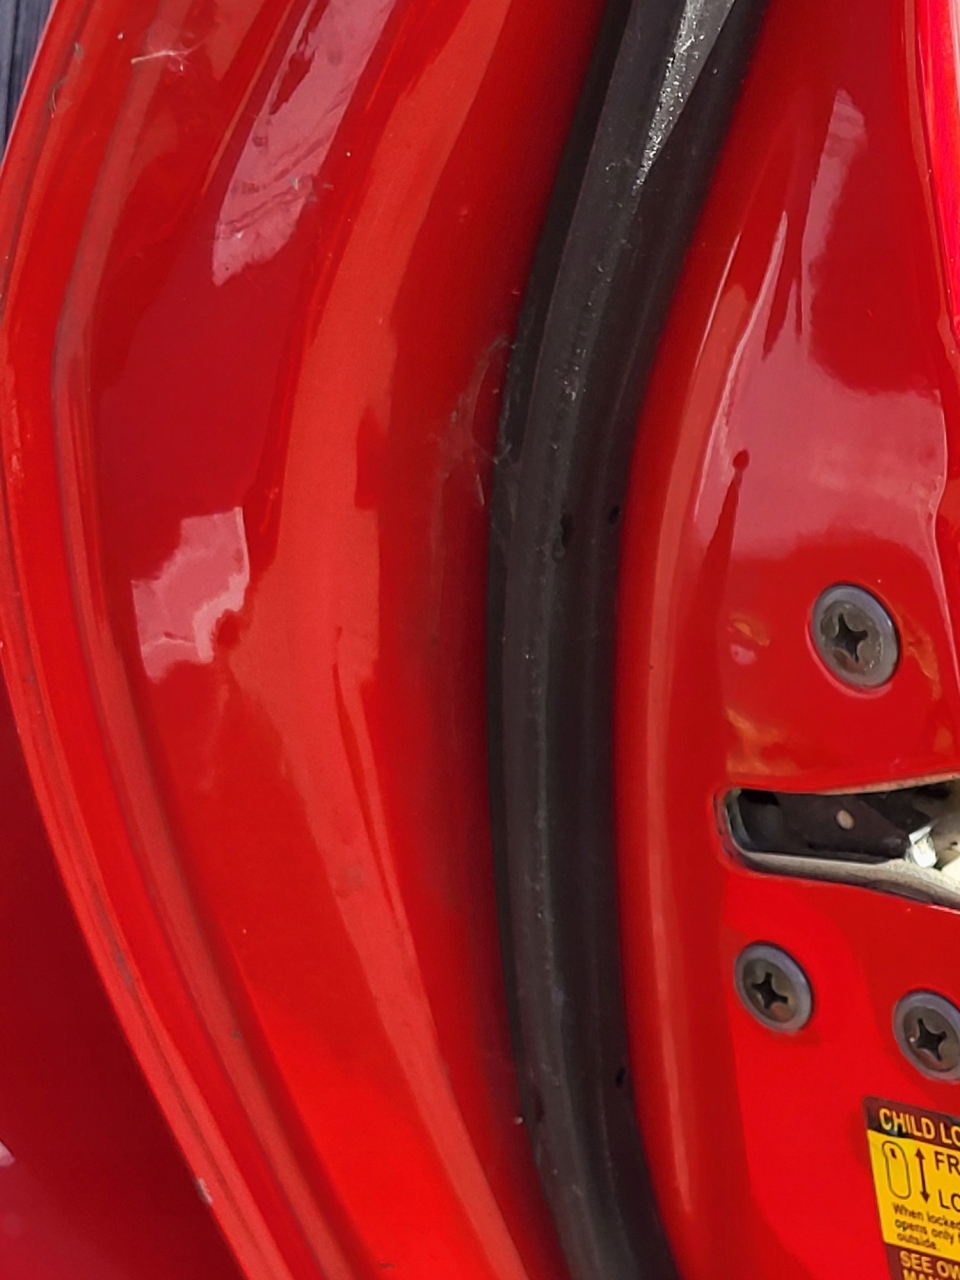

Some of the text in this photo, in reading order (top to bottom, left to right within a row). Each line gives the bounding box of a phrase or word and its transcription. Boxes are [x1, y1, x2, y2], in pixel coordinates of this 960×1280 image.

[879, 1108, 936, 1140] CHILD
[892, 1202, 924, 1221] When
[895, 1219, 928, 1237] opens
[931, 1228, 954, 1246] only
[900, 1251, 933, 1274] SEE
